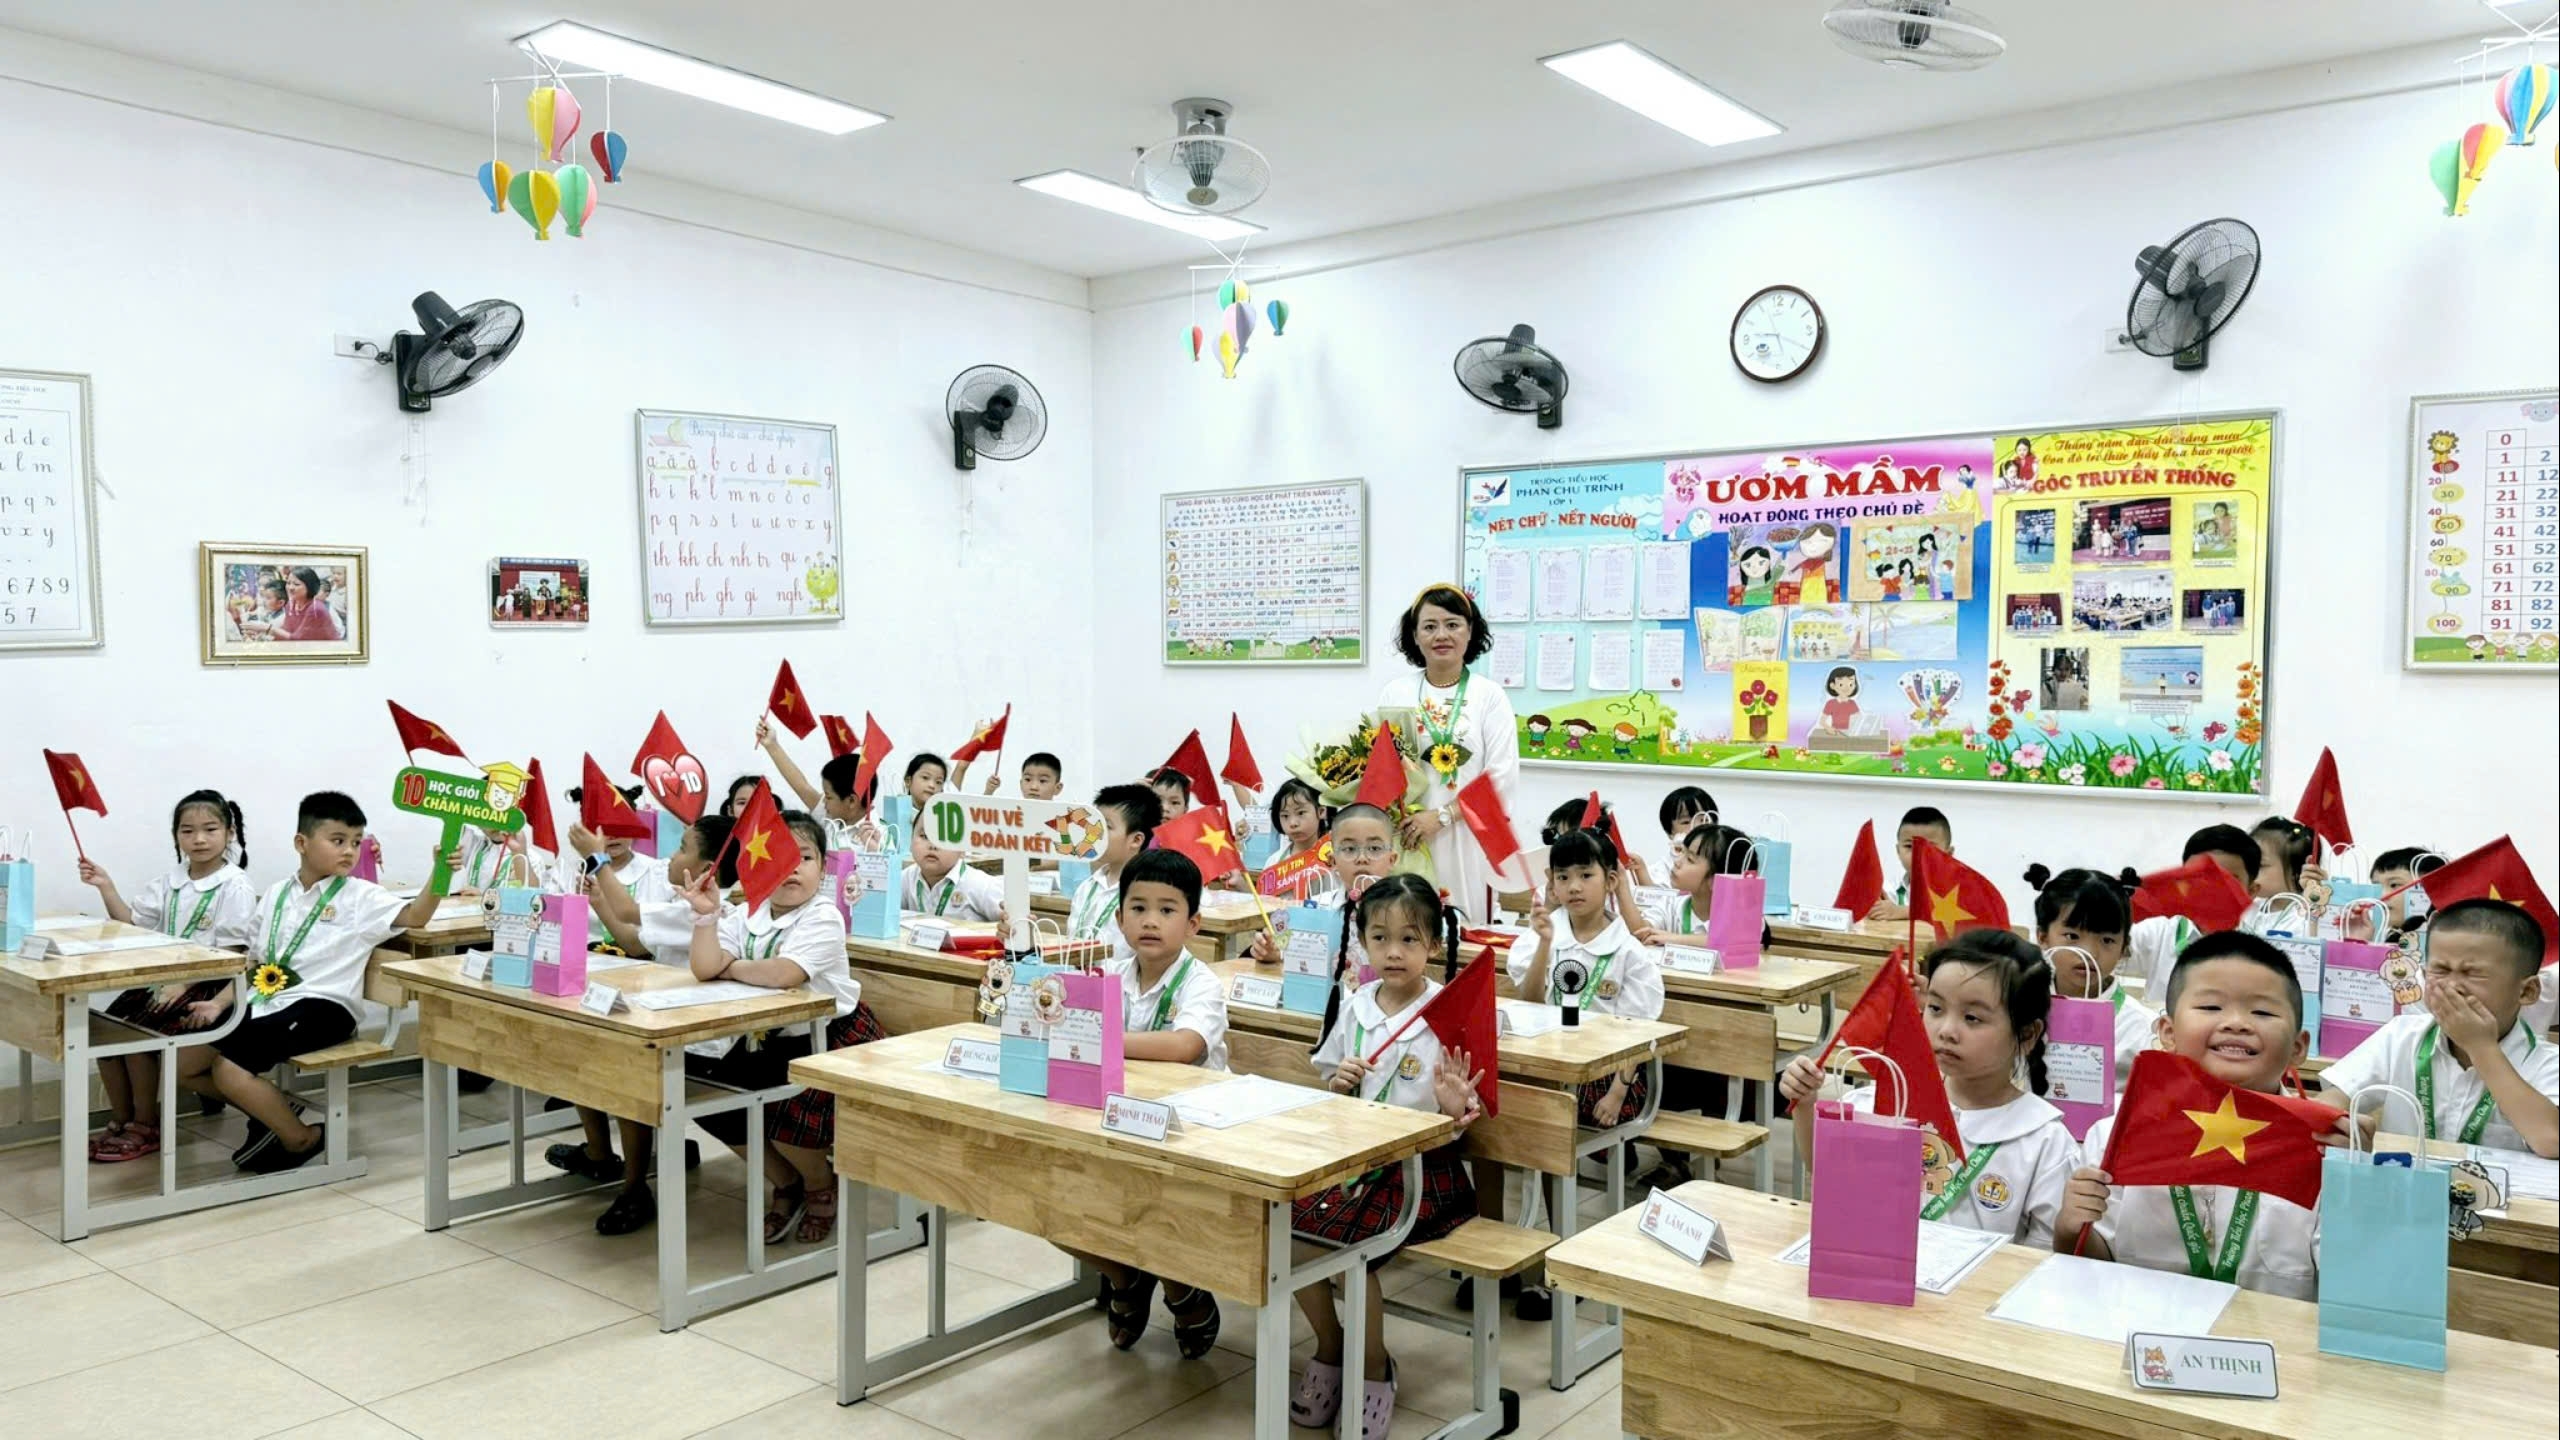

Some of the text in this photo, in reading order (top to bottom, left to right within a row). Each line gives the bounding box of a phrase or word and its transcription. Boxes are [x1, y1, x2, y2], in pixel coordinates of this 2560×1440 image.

[2500, 433, 2511, 445] 0
[2501, 450, 2551, 464] 1 2
[1706, 455, 1943, 503] ƯƠM MẦM
[2033, 461, 2236, 494] GÓC TRUYỀN THỐNG
[2498, 469, 2559, 483] 11 12
[1516, 486, 1550, 497] PHAN
[1585, 482, 1624, 493] TRINH
[2496, 488, 2558, 501] 21 22
[1558, 508, 1587, 526] NẾT
[1590, 511, 1639, 530] NGƯỜI
[1814, 505, 1859, 520] THEO
[2495, 505, 2557, 519] 31 32
[2494, 524, 2556, 537] 41 42
[2430, 539, 2444, 547] 60
[2493, 543, 2556, 556] 51 52
[2492, 561, 2554, 574] 61 62
[8, 577, 69, 594] 6 7 8 9
[2492, 580, 2554, 593] 71 72
[2491, 599, 2553, 611] 81 82
[4, 607, 36, 624] 5 7
[2435, 619, 2456, 627] 100
[2490, 618, 2553, 630] 91 92
[429, 779, 480, 800] HỌC GIỎI
[423, 795, 509, 824] CHĂM NGOAN
[970, 805, 1024, 828] VUI VẺ
[970, 829, 1053, 854] ĐOÀN KẾT
[2180, 1354, 2262, 1375] AN THỊNH
